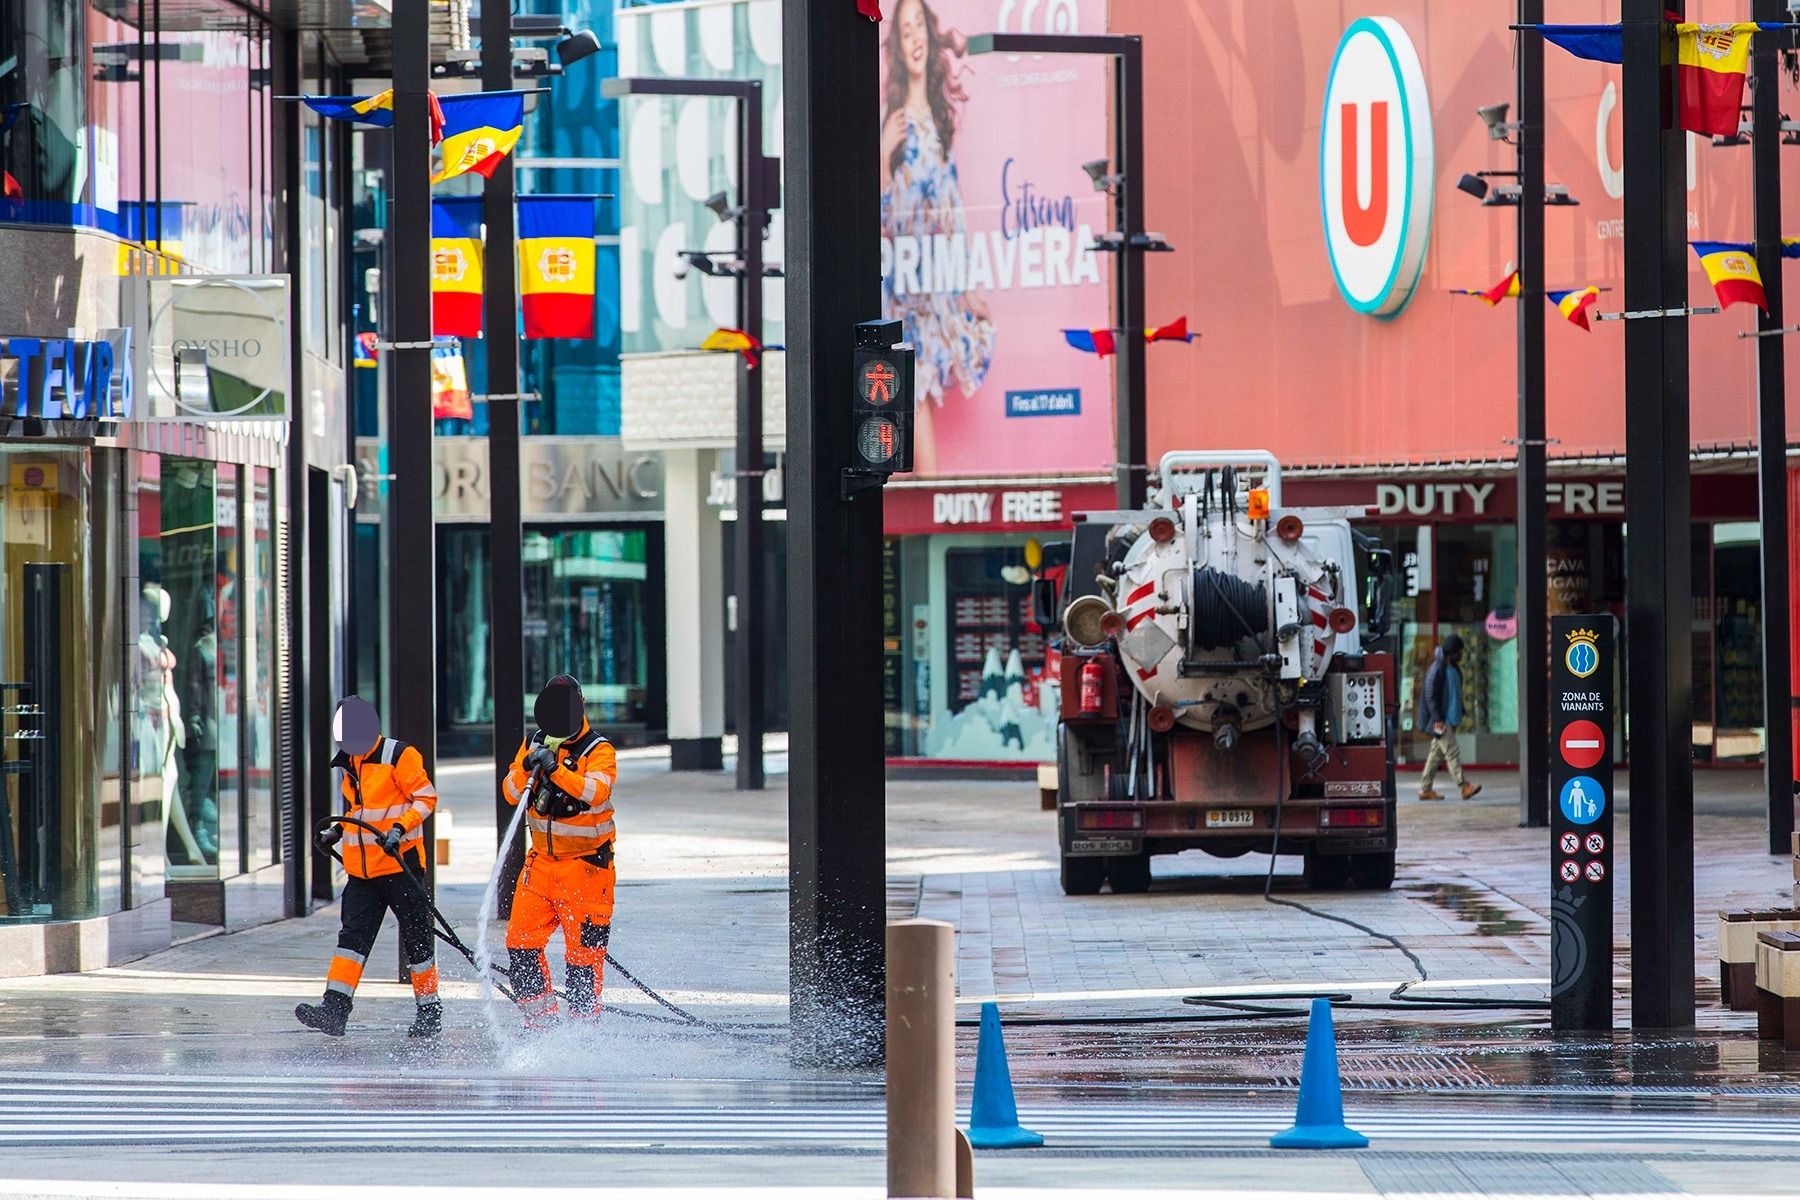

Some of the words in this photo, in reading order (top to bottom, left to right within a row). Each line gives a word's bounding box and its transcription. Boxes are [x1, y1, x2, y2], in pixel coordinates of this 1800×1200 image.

[1341, 101, 1388, 246] U
[0, 338, 114, 419] TEUR
[528, 456, 660, 501] BANC
[933, 492, 994, 524] DUTY
[1001, 490, 1063, 523] FREE
[1376, 483, 1496, 515] DUTY
[1546, 482, 1626, 514] FRE
[1561, 702, 1604, 711] VIANANTS
[1562, 692, 1587, 701] ZONA
[1589, 692, 1601, 701] DE
